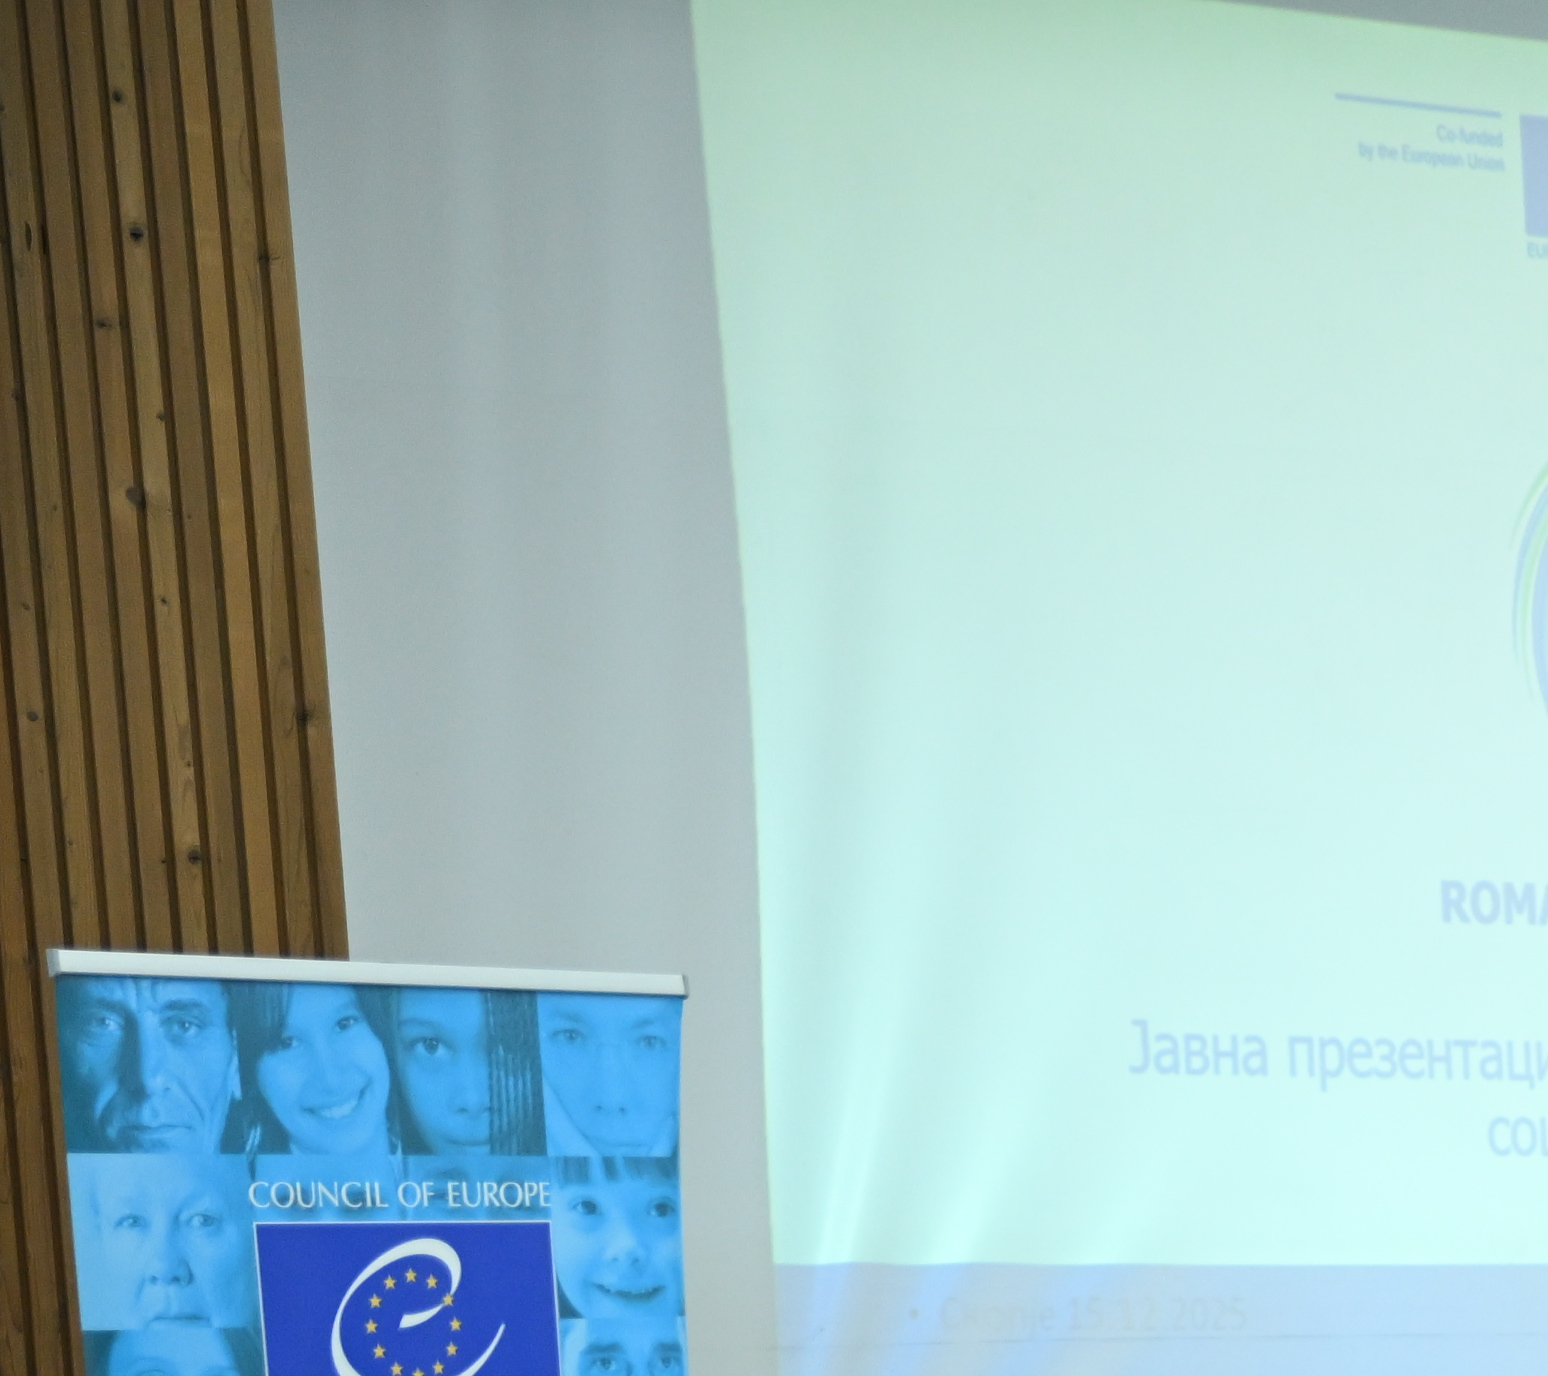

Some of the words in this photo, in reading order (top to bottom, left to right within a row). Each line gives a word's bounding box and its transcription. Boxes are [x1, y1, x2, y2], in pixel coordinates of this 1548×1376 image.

[1436, 123, 1503, 147] Co-funded
[1357, 141, 1374, 161] by
[1377, 144, 1399, 160] the
[1401, 144, 1465, 169] European
[1467, 153, 1505, 172] Union
[1127, 1016, 1269, 1078] Јавна
[247, 1180, 389, 1209] COUNCIL
[397, 1181, 436, 1208] OF
[446, 1181, 552, 1208] EUROPE
